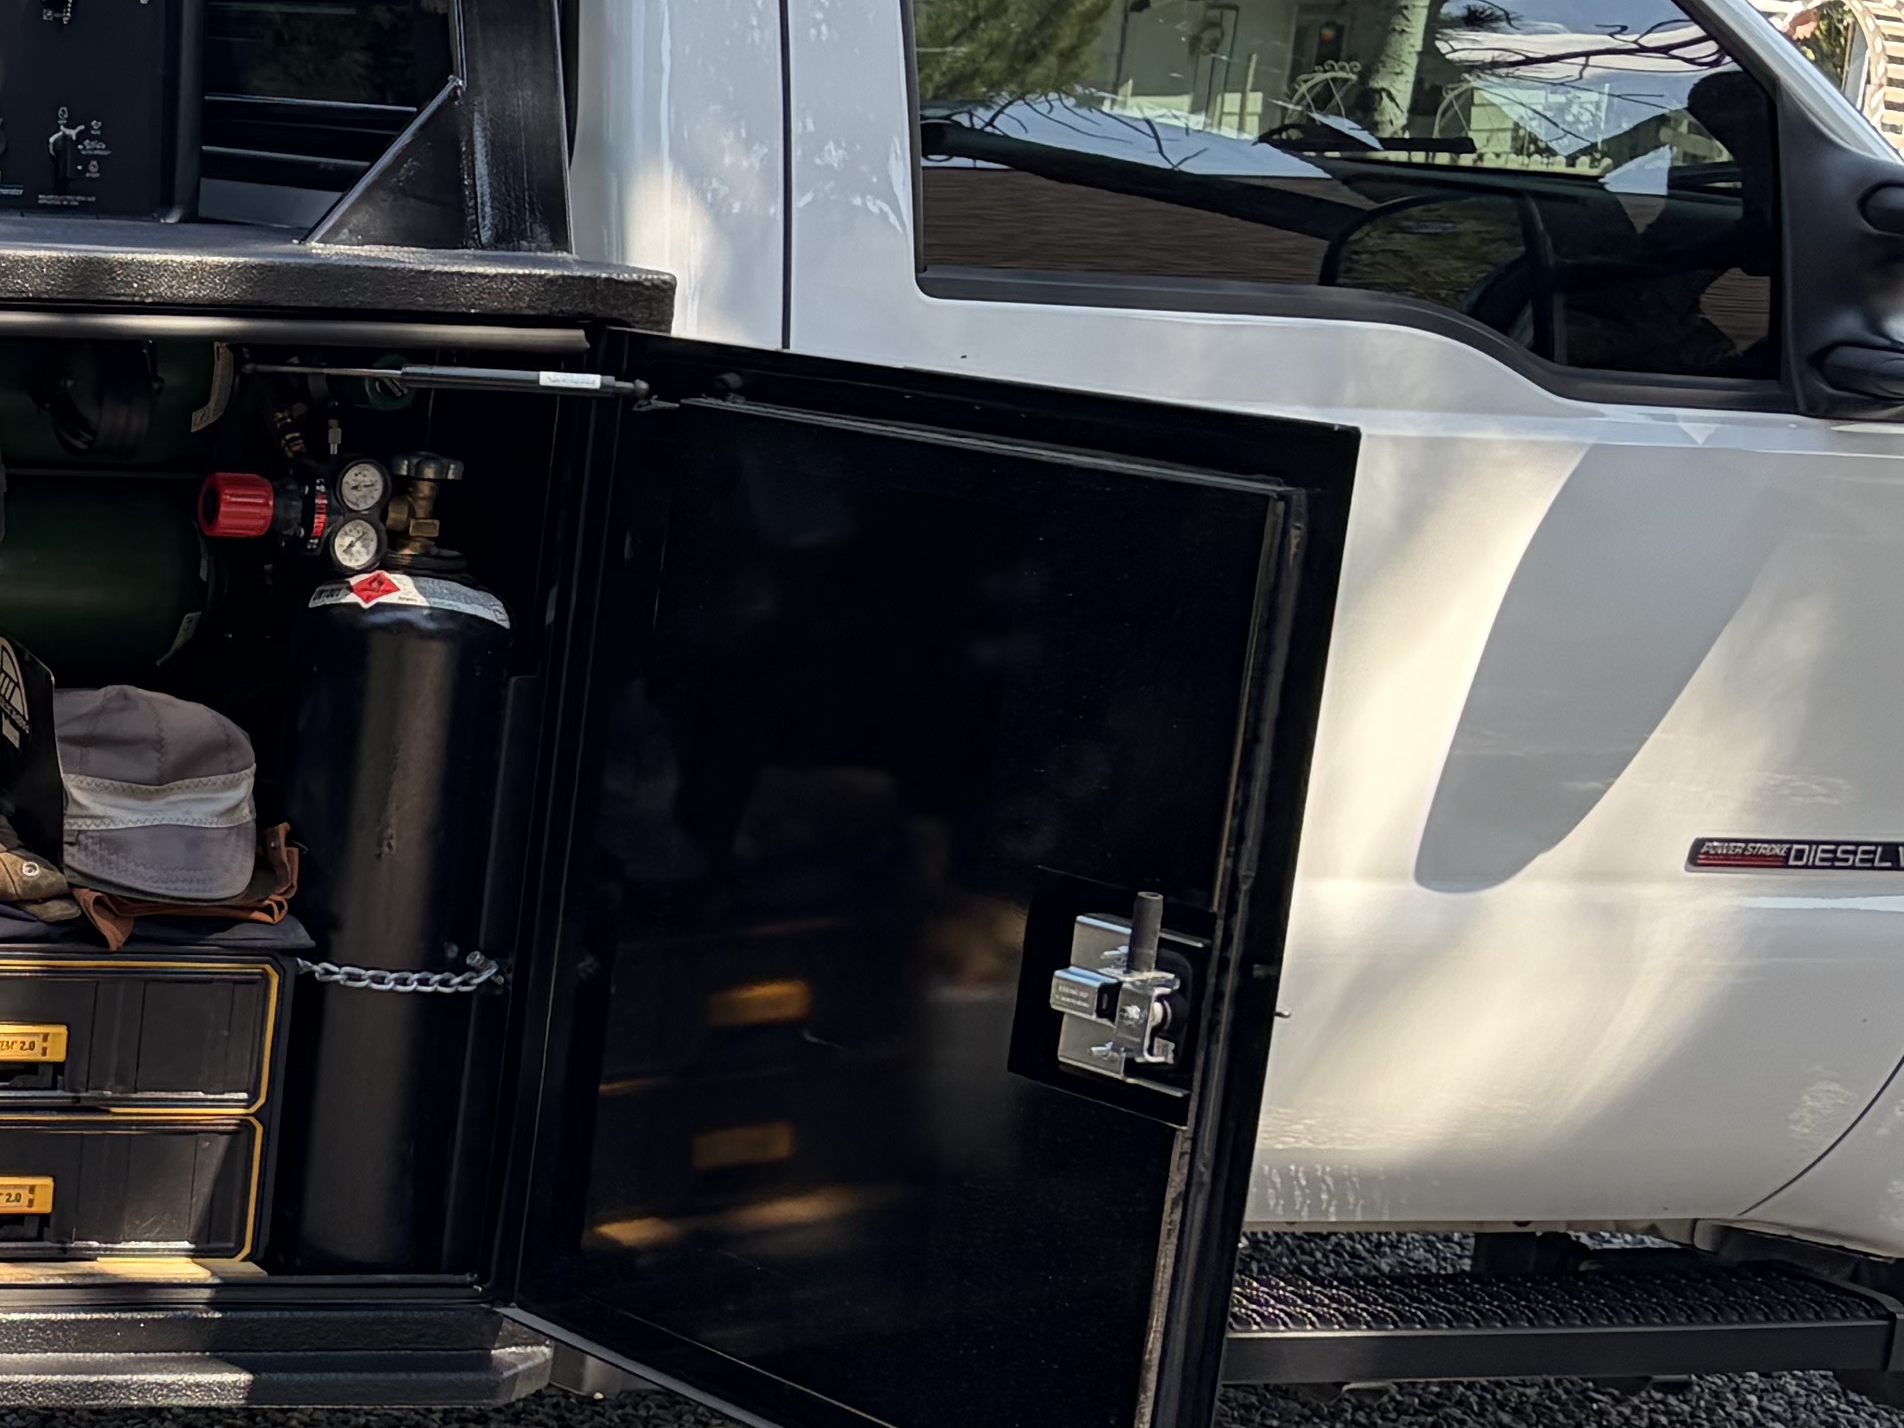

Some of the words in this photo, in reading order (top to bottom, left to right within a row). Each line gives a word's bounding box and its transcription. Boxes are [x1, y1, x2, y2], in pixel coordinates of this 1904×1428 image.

[1700, 841, 1744, 854] POWER
[1745, 843, 1790, 856] STROKE
[1788, 844, 1892, 867] DIESEL
[19, 1040, 36, 1052] 2.0
[5, 1192, 22, 1204] 2.0
